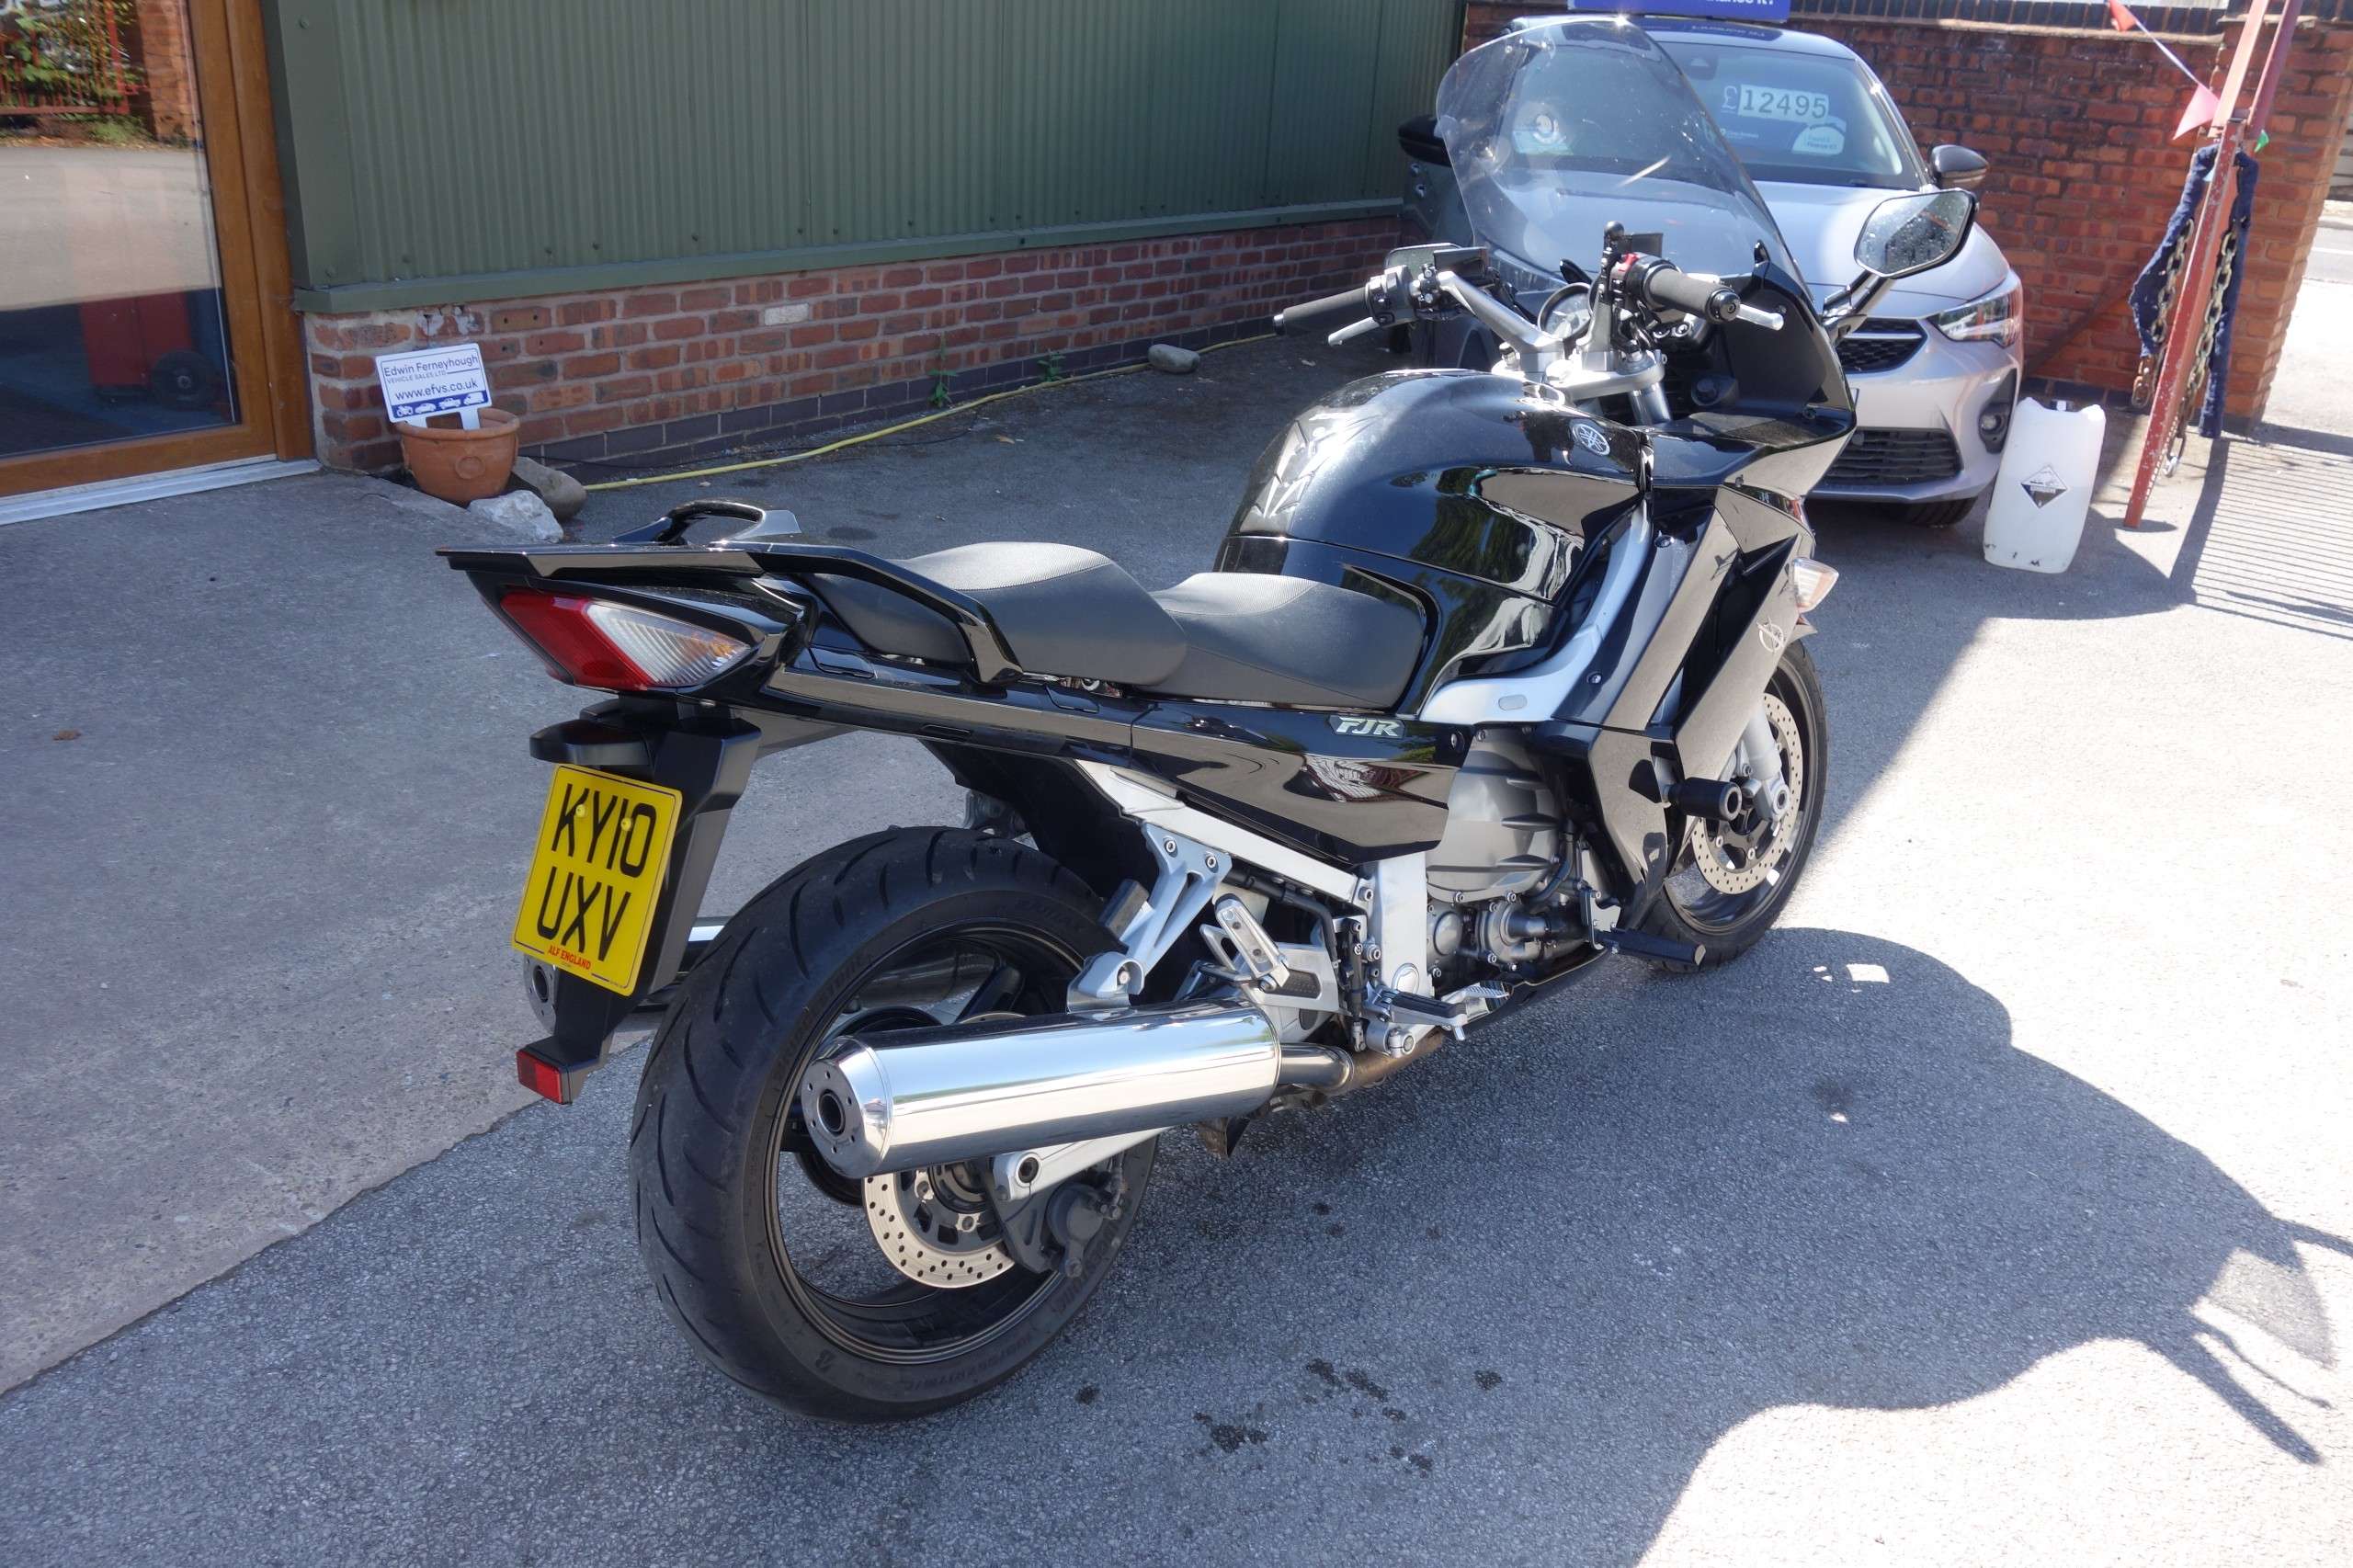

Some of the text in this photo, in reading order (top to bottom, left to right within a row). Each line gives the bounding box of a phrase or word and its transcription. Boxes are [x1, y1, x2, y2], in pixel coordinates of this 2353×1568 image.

[384, 355, 478, 377] Edwin Ferneyhough
[395, 378, 478, 400] www.efvs.co.uk
[1336, 716, 1401, 736] FJR
[551, 783, 657, 878] KY10
[537, 866, 631, 961] UXV
[548, 945, 591, 971] ALF ENGLAND
